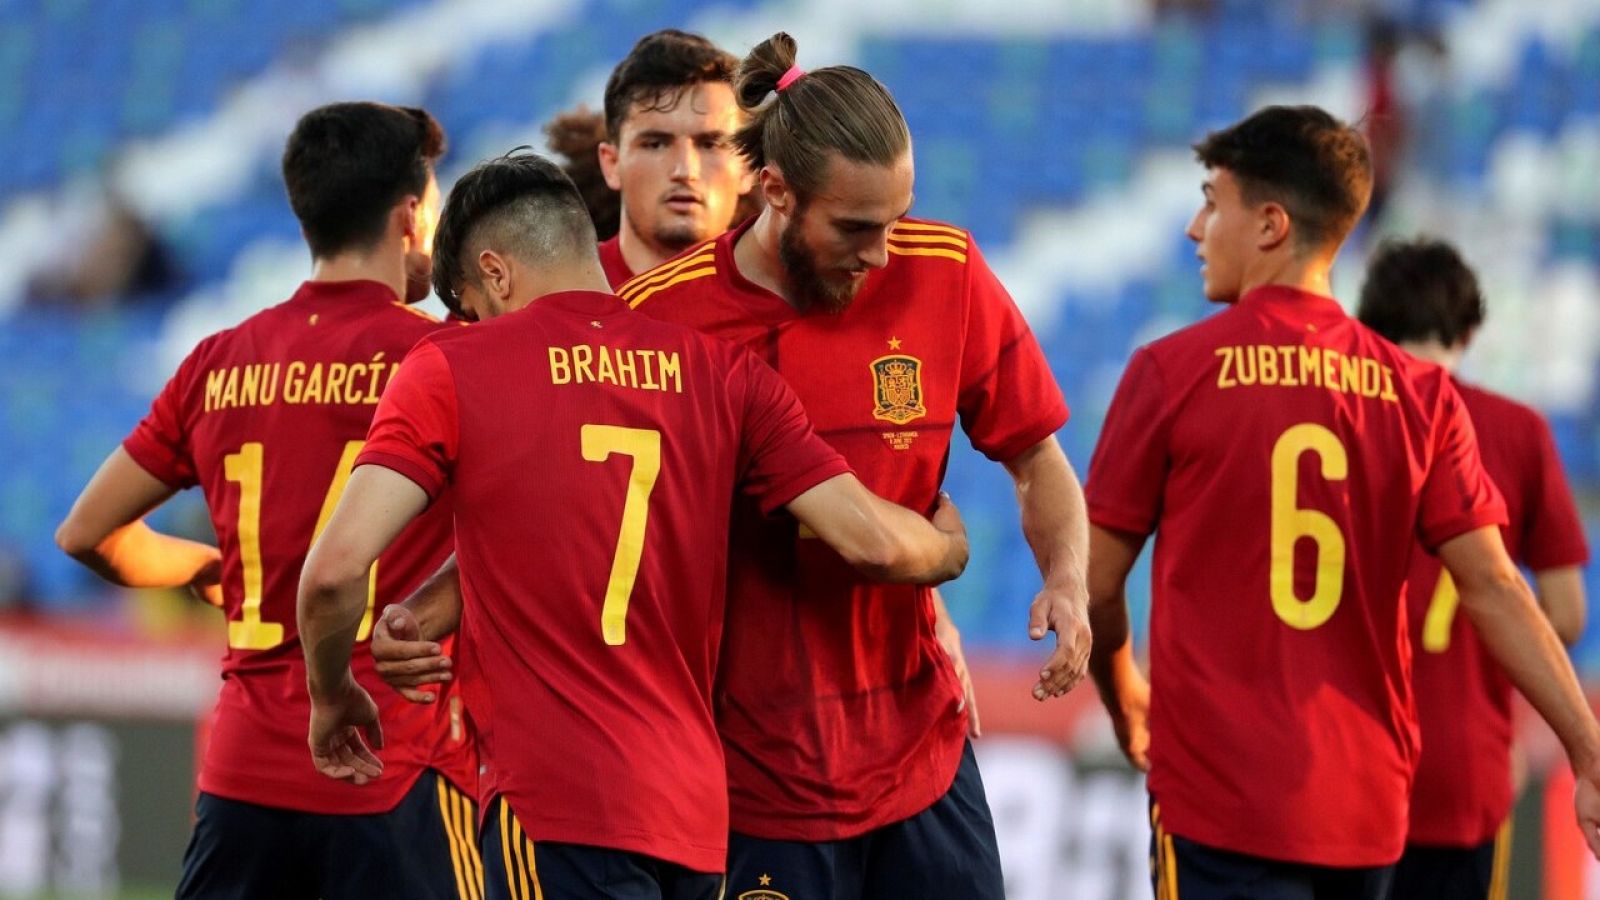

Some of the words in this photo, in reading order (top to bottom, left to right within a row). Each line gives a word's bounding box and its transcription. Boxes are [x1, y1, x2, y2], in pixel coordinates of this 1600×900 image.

[204, 361, 281, 413] MANU
[548, 344, 682, 393] BRAHIM
[1214, 344, 1399, 403] ZUBIMENDI
[581, 424, 661, 646] 7
[1269, 423, 1348, 629] 6
